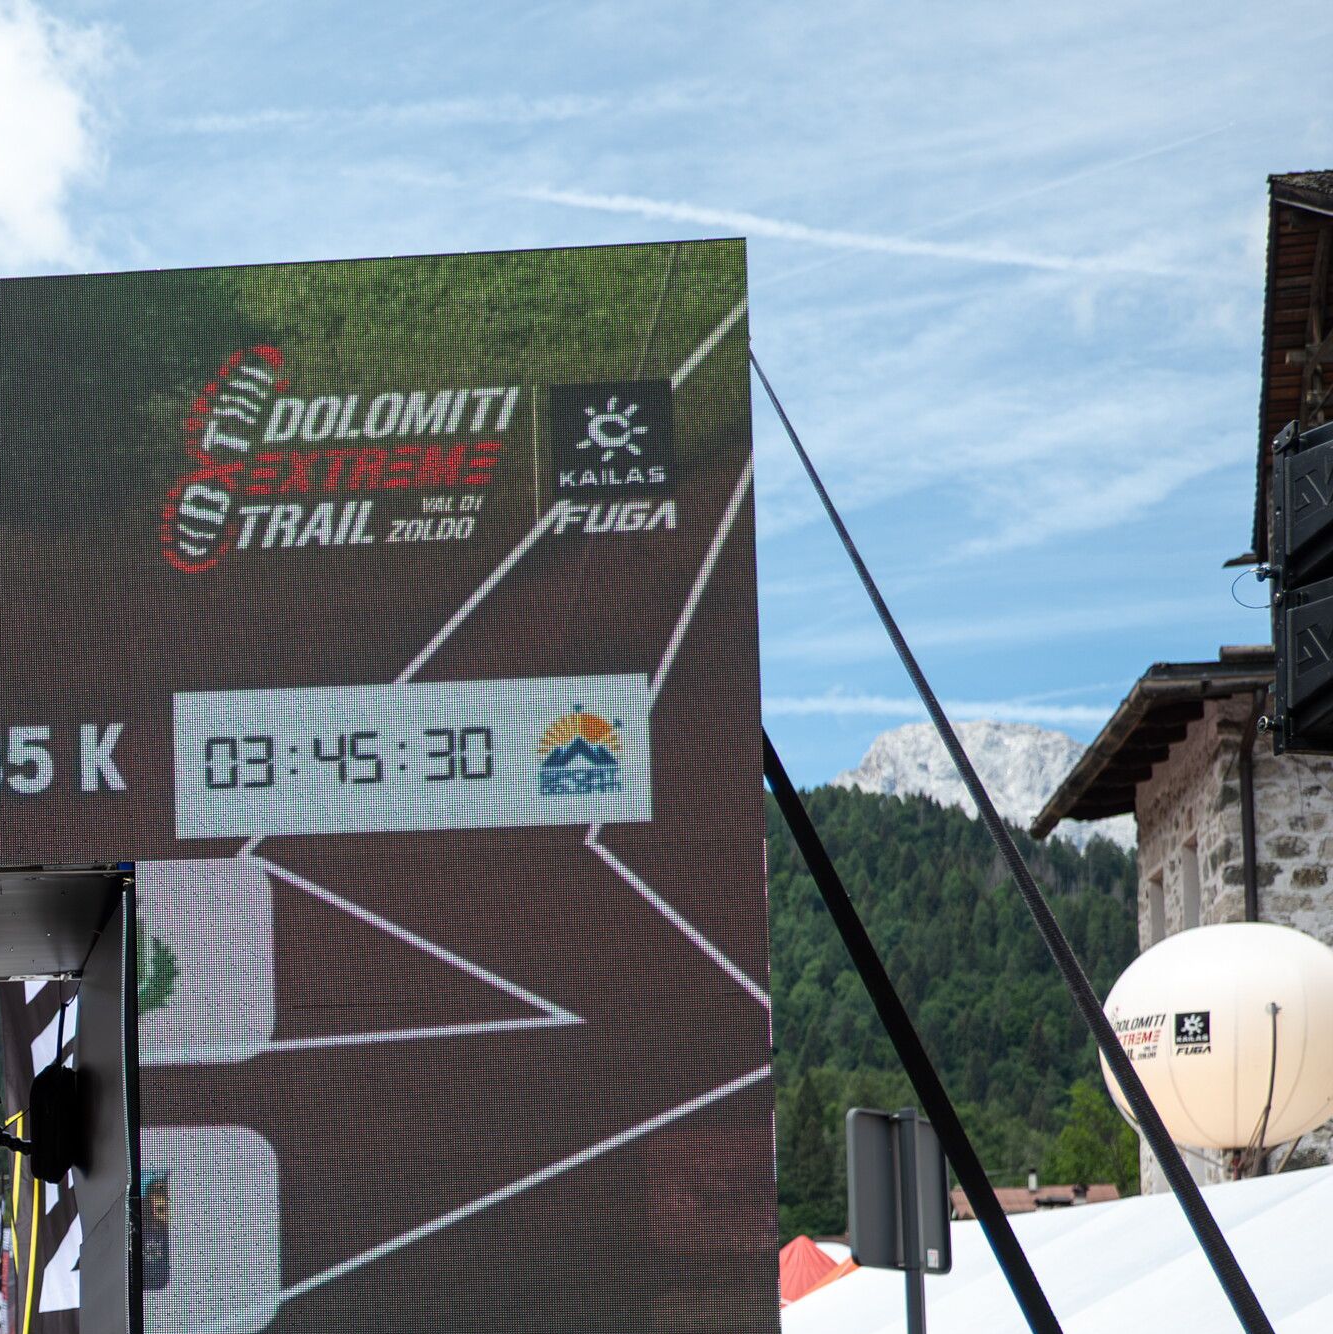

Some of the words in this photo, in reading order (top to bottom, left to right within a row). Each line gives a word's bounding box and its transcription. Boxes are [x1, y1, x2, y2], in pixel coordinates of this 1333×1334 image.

[262, 386, 520, 443] DOLOMITI
[246, 440, 502, 493] EXTREME
[559, 465, 664, 488] KAILAS
[237, 500, 374, 549] TRAIL
[386, 517, 475, 543] ZOLDO
[554, 500, 677, 535] FUGA
[80, 721, 129, 793] K
[203, 725, 495, 790] 03:45:30
[1176, 1046, 1211, 1056] FUGA
